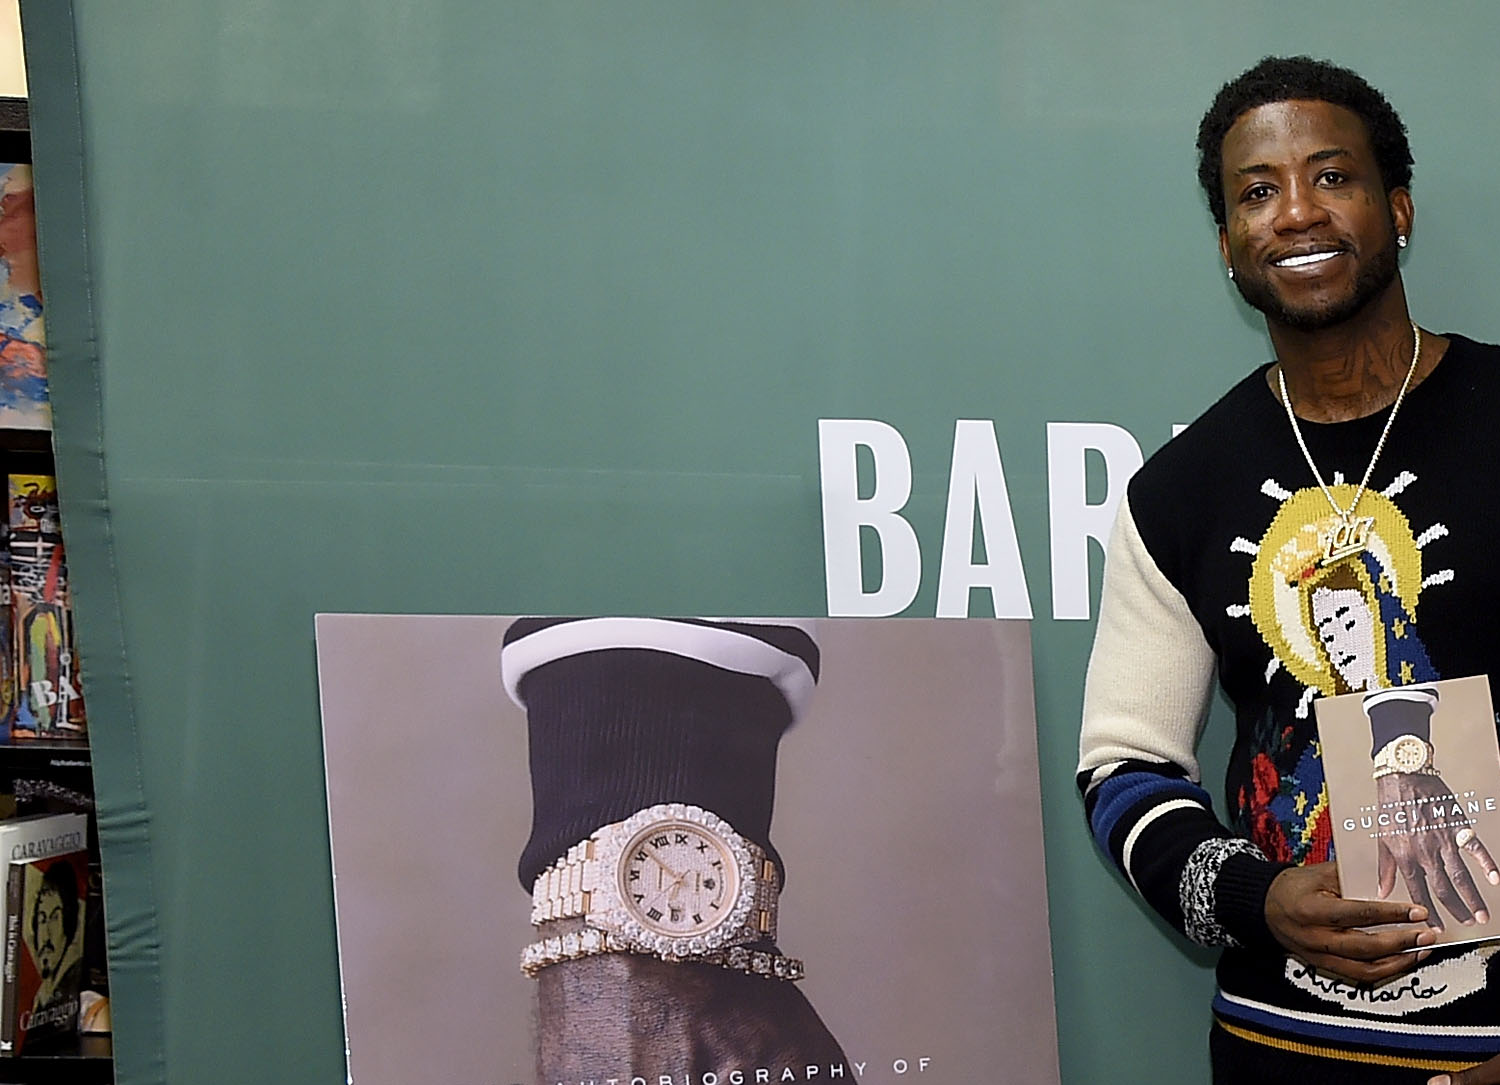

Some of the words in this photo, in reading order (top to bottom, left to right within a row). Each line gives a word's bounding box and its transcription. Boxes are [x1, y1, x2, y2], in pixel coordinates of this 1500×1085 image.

[818, 419, 1144, 621] BAR
[1343, 809, 1418, 831] GUCCI
[1432, 798, 1496, 818] MANE
[1347, 977, 1448, 1003] Maria
[893, 1057, 933, 1075] OF
